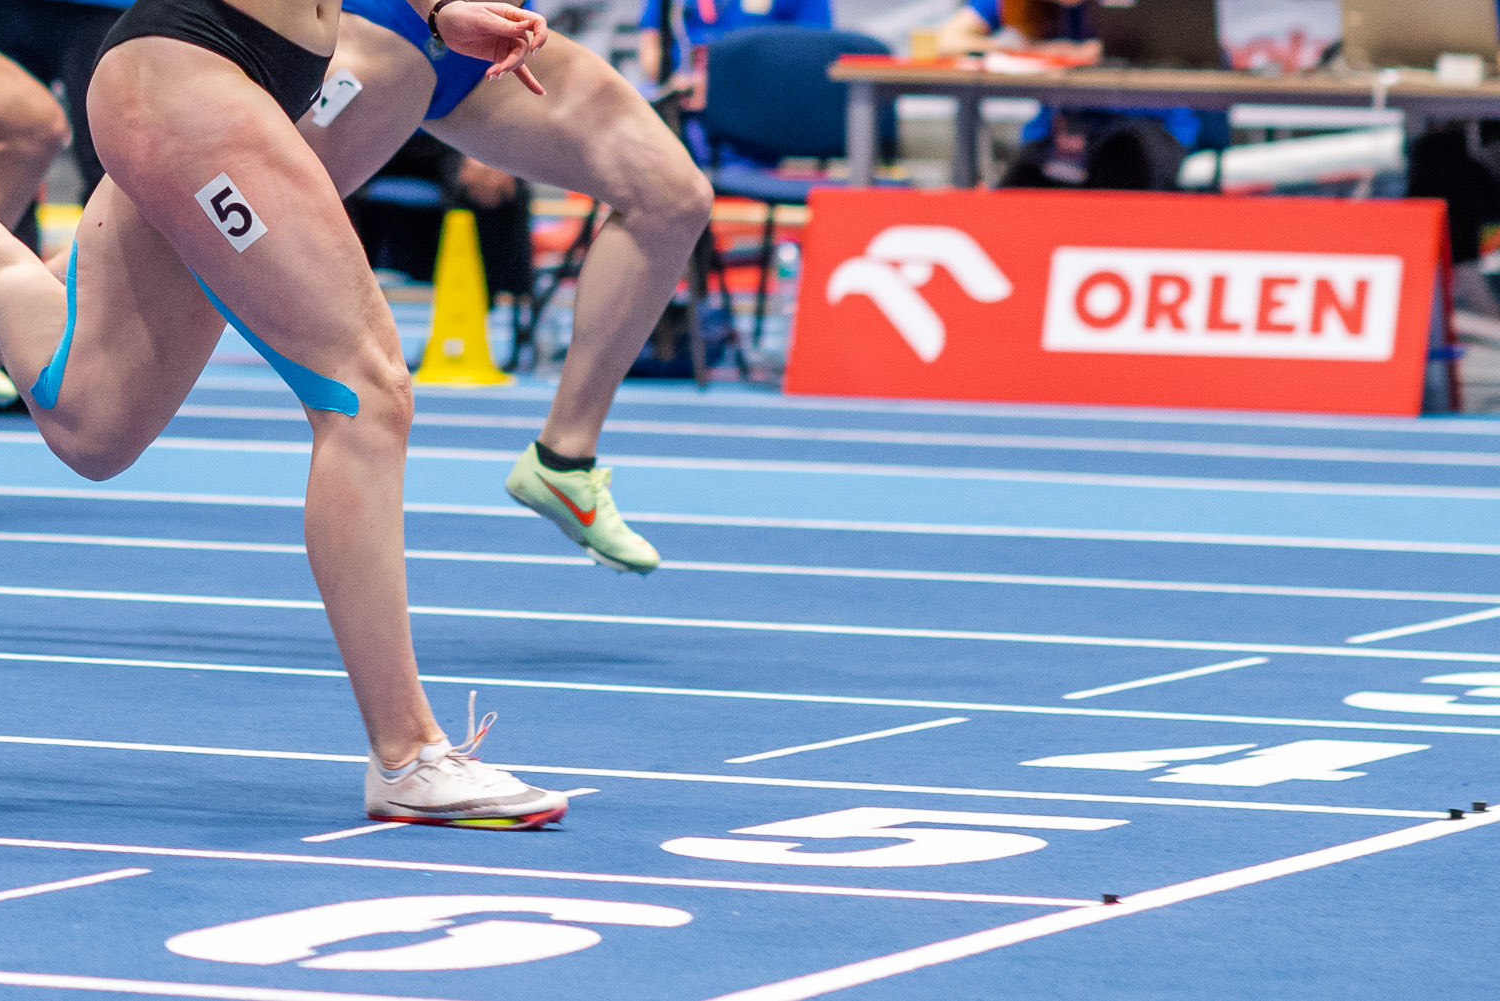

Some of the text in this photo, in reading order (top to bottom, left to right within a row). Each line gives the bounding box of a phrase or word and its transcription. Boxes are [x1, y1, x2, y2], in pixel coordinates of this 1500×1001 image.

[210, 185, 253, 237] 5
[1073, 269, 1370, 336] ORLEN
[659, 806, 1131, 867] 5
[164, 894, 693, 972] 6
